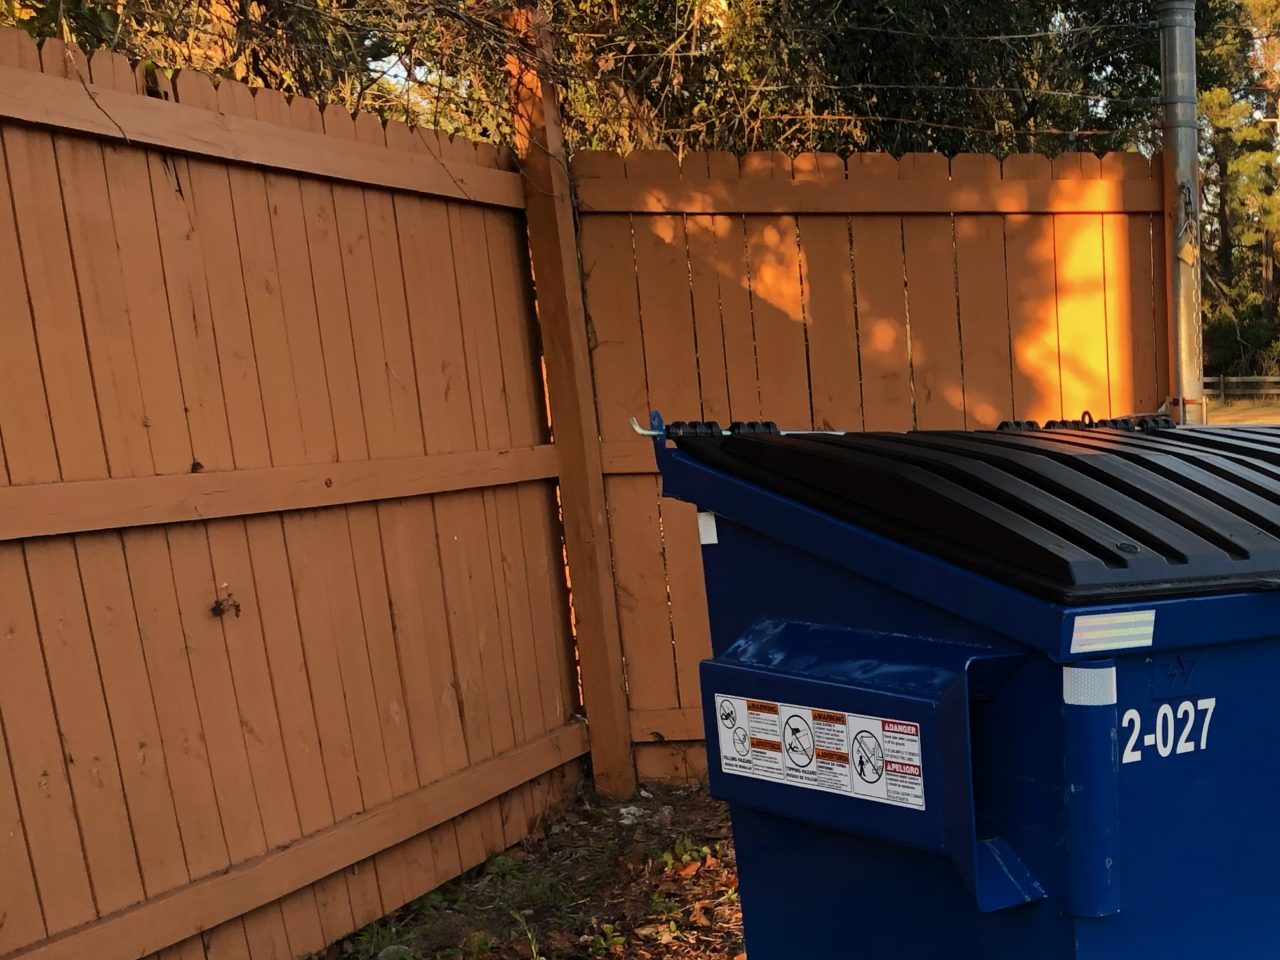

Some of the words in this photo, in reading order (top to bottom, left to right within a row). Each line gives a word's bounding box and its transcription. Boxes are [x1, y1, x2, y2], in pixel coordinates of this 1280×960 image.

[888, 723, 917, 735] DANGER
[1122, 698, 1216, 763] 2-027
[891, 763, 920, 775] PELIGRO
